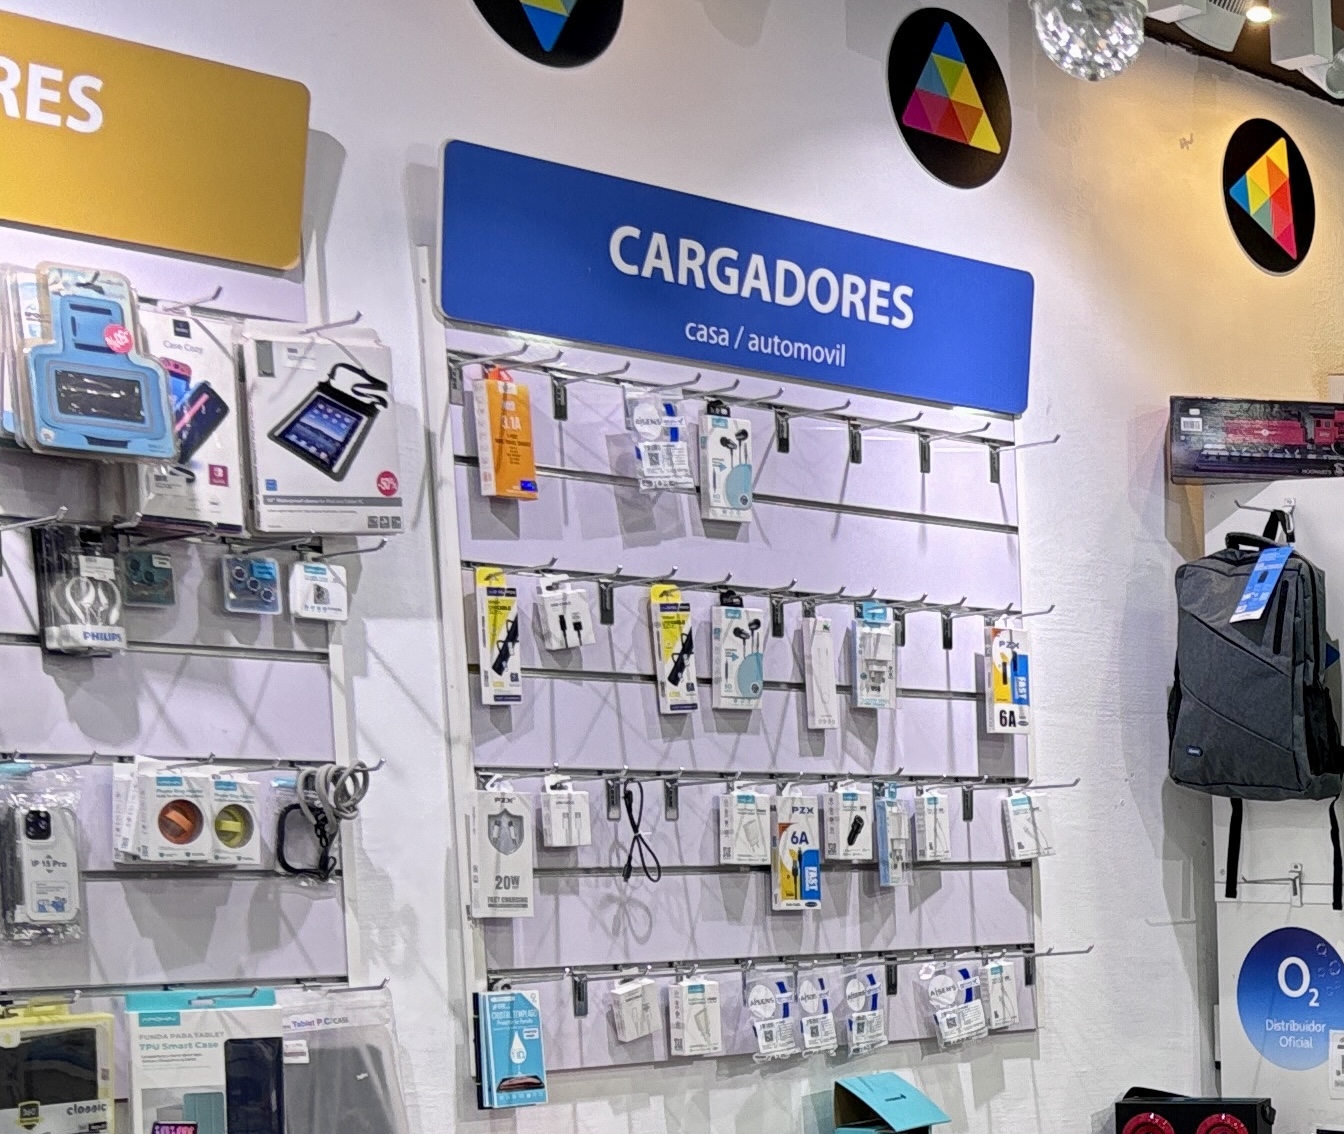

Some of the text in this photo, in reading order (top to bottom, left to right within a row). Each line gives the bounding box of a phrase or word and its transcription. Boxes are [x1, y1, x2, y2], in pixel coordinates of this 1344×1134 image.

[610, 226, 915, 329] CARGADORES
[685, 320, 730, 347] casa
[747, 329, 847, 368] automovil
[83, 631, 122, 642] PHILIPS
[999, 709, 1016, 727] 6A
[791, 806, 814, 815] PZX
[791, 831, 809, 845] 6A
[1265, 1019, 1327, 1032] Distribuidor
[1279, 1036, 1313, 1049] Oficial
